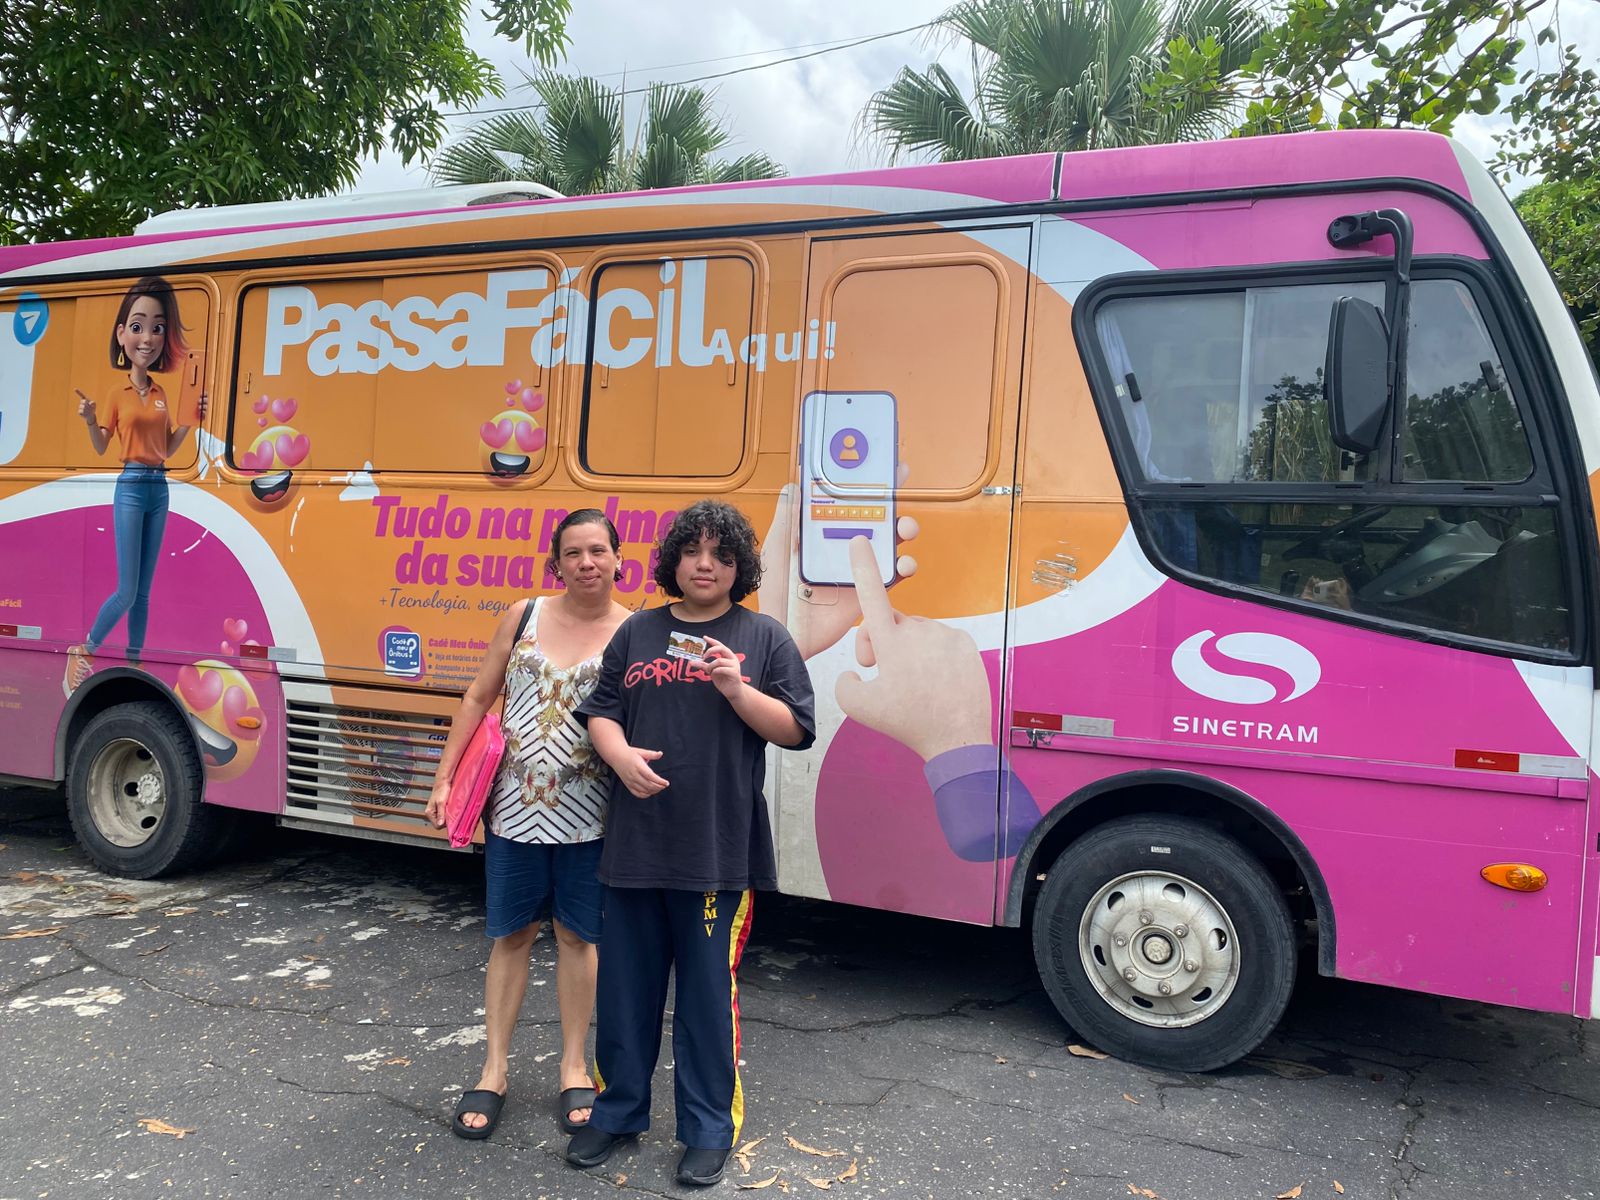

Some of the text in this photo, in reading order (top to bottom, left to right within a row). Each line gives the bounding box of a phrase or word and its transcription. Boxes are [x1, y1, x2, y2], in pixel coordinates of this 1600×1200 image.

[263, 256, 836, 376] PassaFácil Aqui!
[372, 495, 677, 553] Tudo na plm
[395, 541, 448, 585] da
[456, 554, 534, 589] sua
[478, 600, 517, 617] segu
[429, 638, 448, 647] Cadê
[624, 653, 751, 688] GORILL
[1172, 715, 1318, 743] SINETRAM
